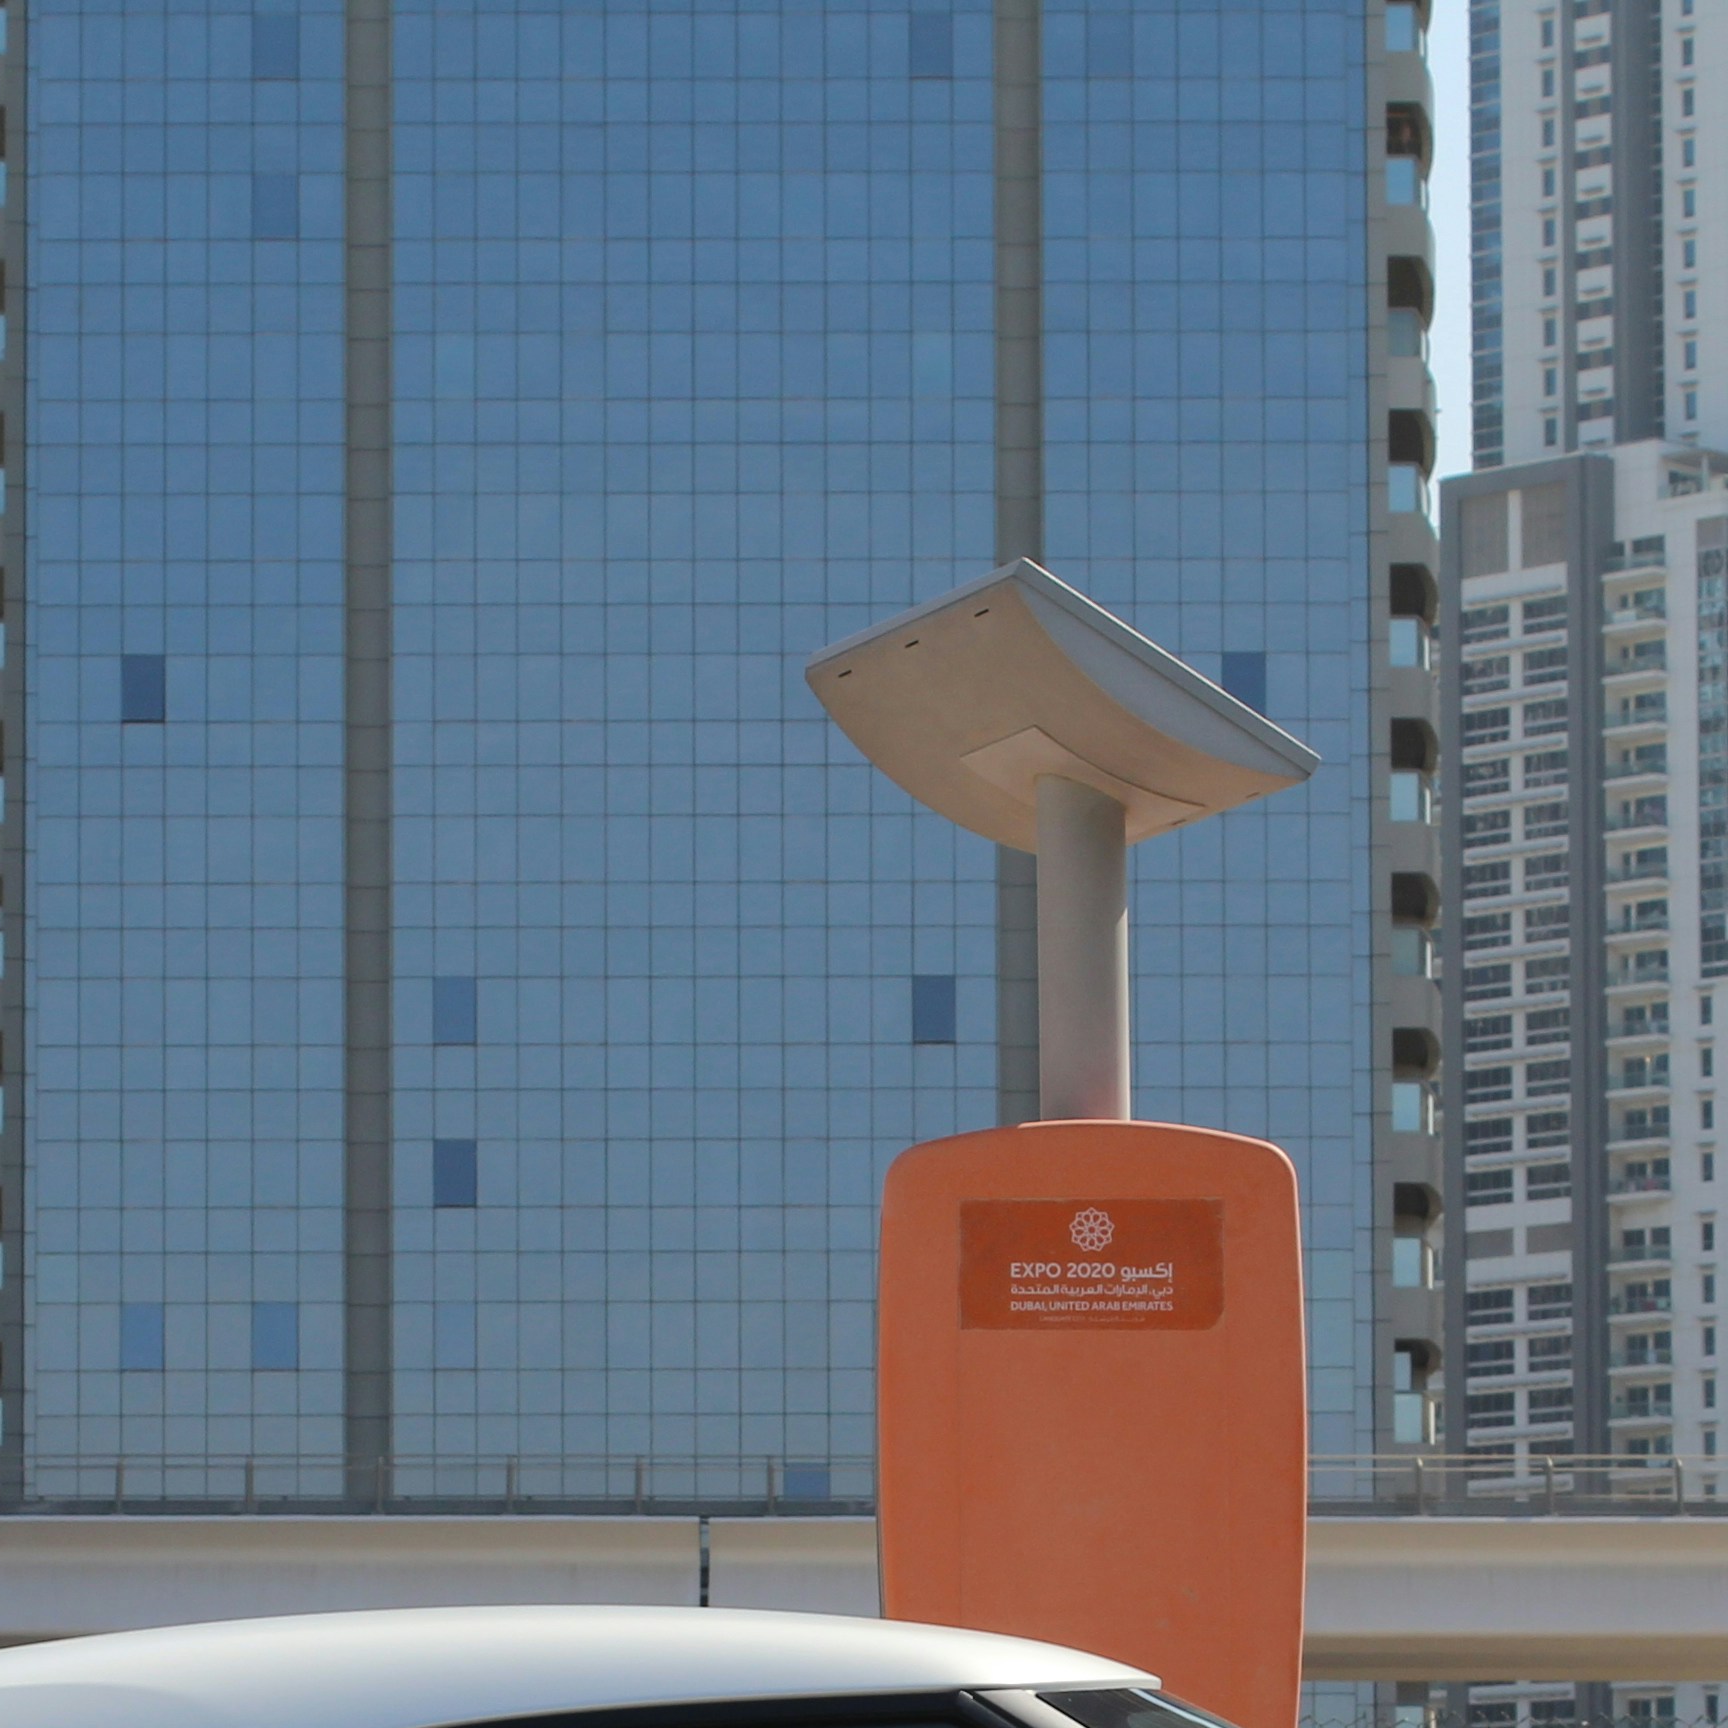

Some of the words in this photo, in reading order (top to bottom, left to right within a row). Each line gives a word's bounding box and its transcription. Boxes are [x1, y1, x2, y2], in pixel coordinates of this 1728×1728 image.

[1010, 1262, 1062, 1279] EXPO
[1066, 1262, 1116, 1279] 2020
[1120, 1262, 1174, 1283] إكسبو
[1010, 1284, 1059, 1295] المتحدة
[1061, 1284, 1103, 1297] العربية
[1010, 1301, 1048, 1312] DUBAI,
[1049, 1301, 1090, 1312] UNITED
[1091, 1301, 1121, 1312] ARAB
[1122, 1301, 1174, 1312] EMIRATES
